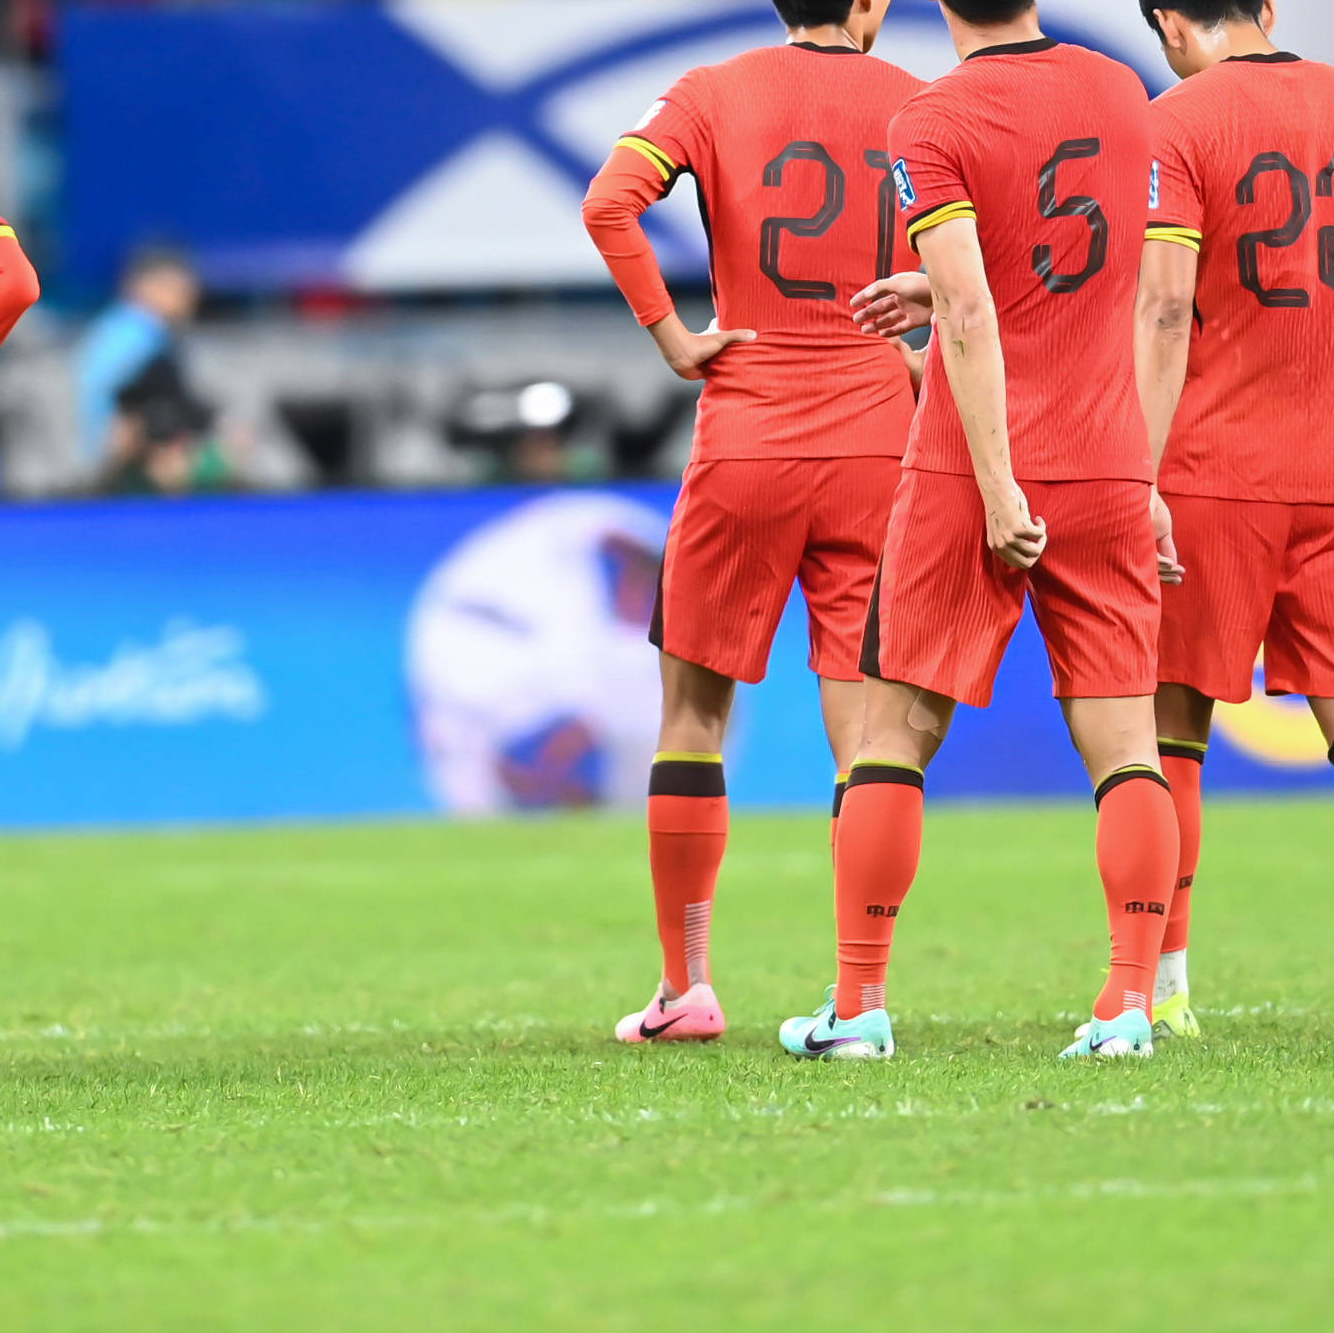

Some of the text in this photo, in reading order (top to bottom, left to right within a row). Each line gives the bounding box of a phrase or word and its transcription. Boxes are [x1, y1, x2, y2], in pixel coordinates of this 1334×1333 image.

[759, 140, 896, 299] 21
[1032, 137, 1107, 294] 5
[1125, 901, 1165, 916] 中国
